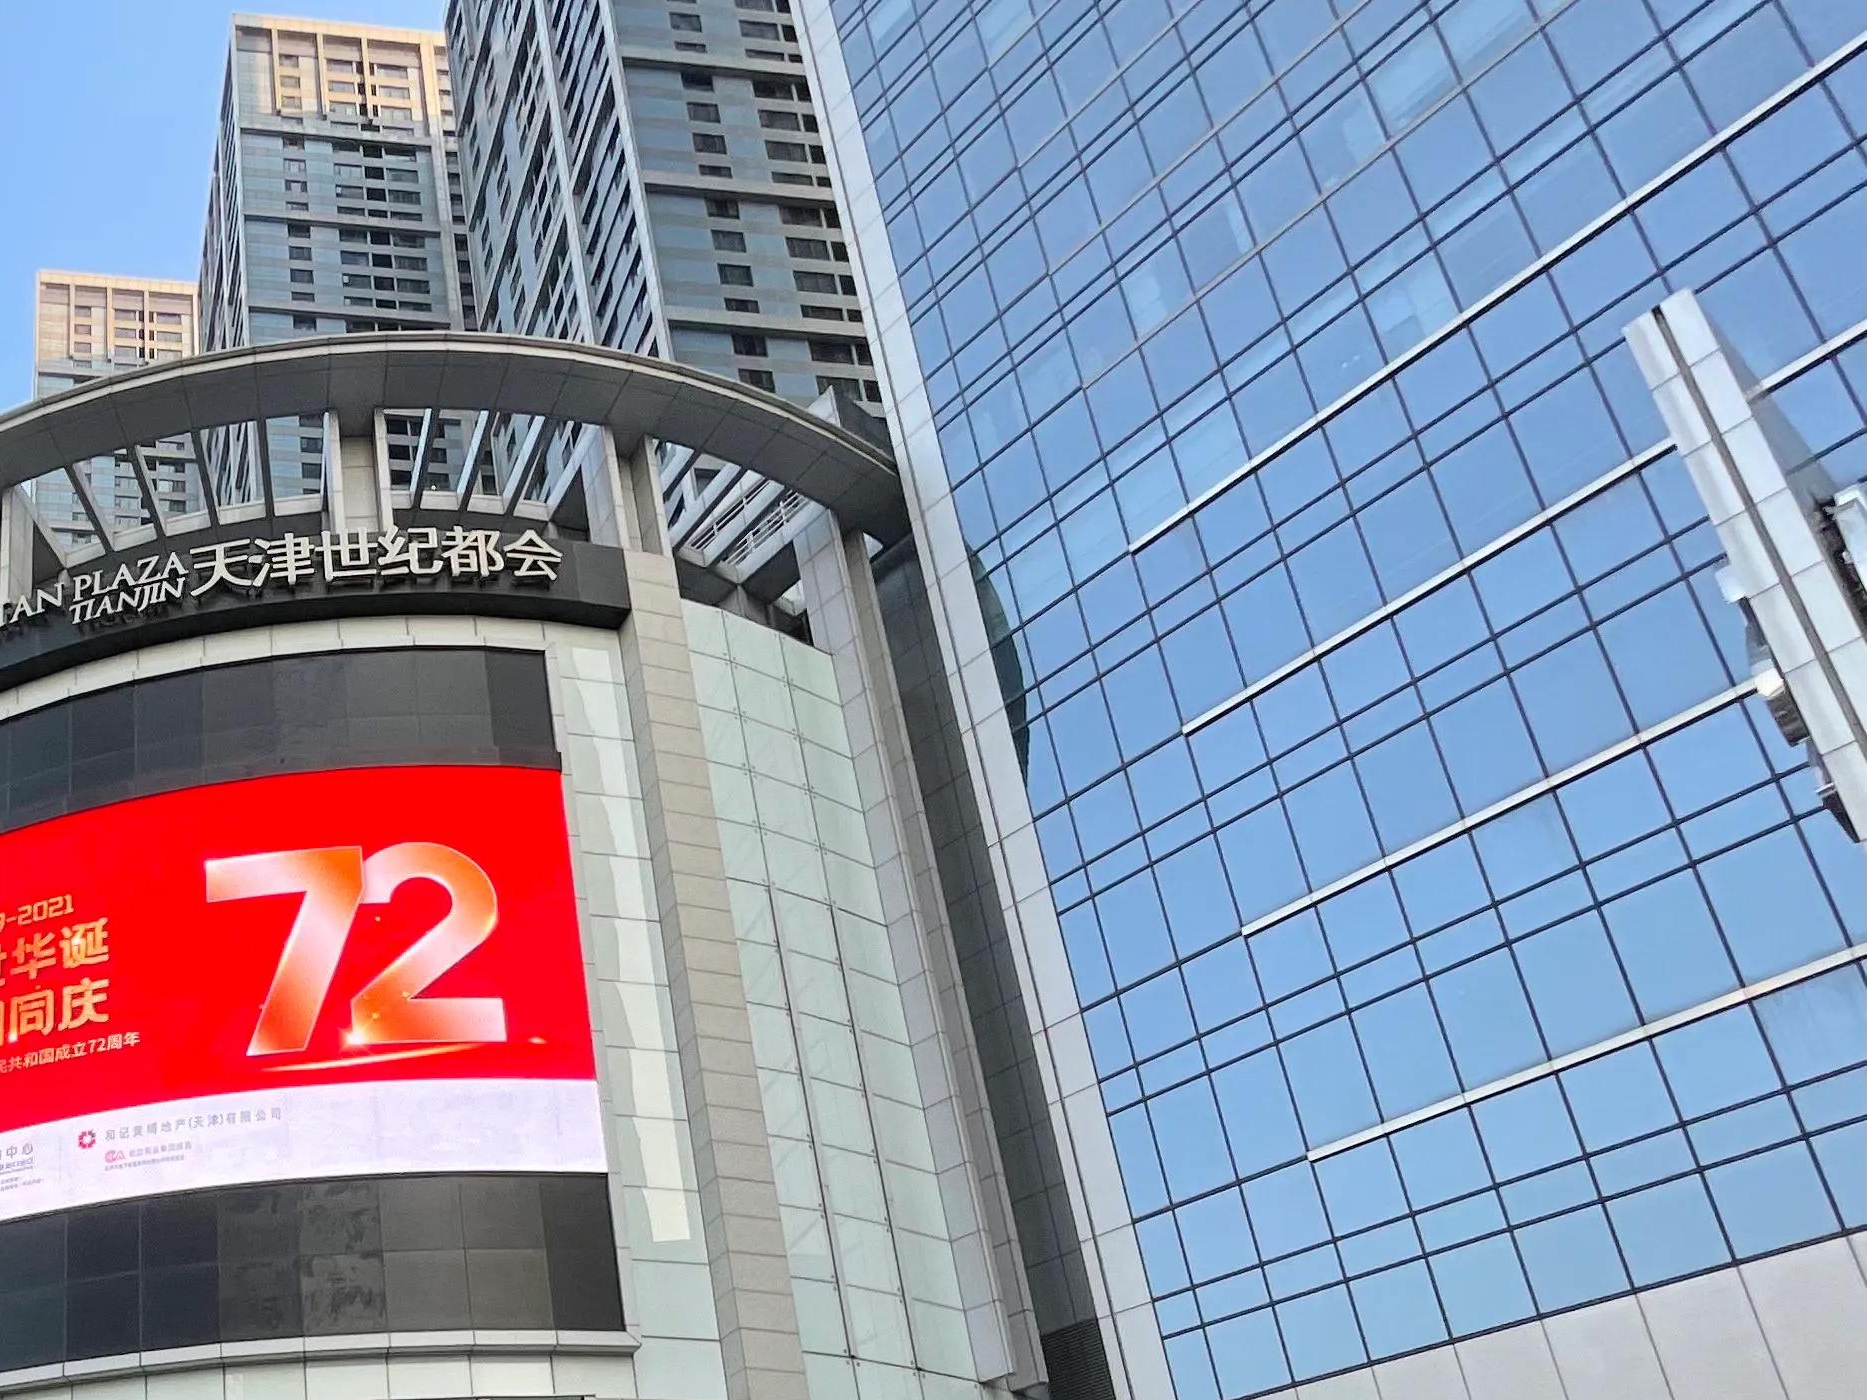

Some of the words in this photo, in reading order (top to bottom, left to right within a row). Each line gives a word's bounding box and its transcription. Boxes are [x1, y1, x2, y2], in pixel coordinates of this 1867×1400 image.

[72, 551, 189, 602] PLAZA
[189, 526, 564, 597] 天津世纪都会
[69, 577, 186, 625] TIANJIN
[205, 841, 509, 1057] 72
